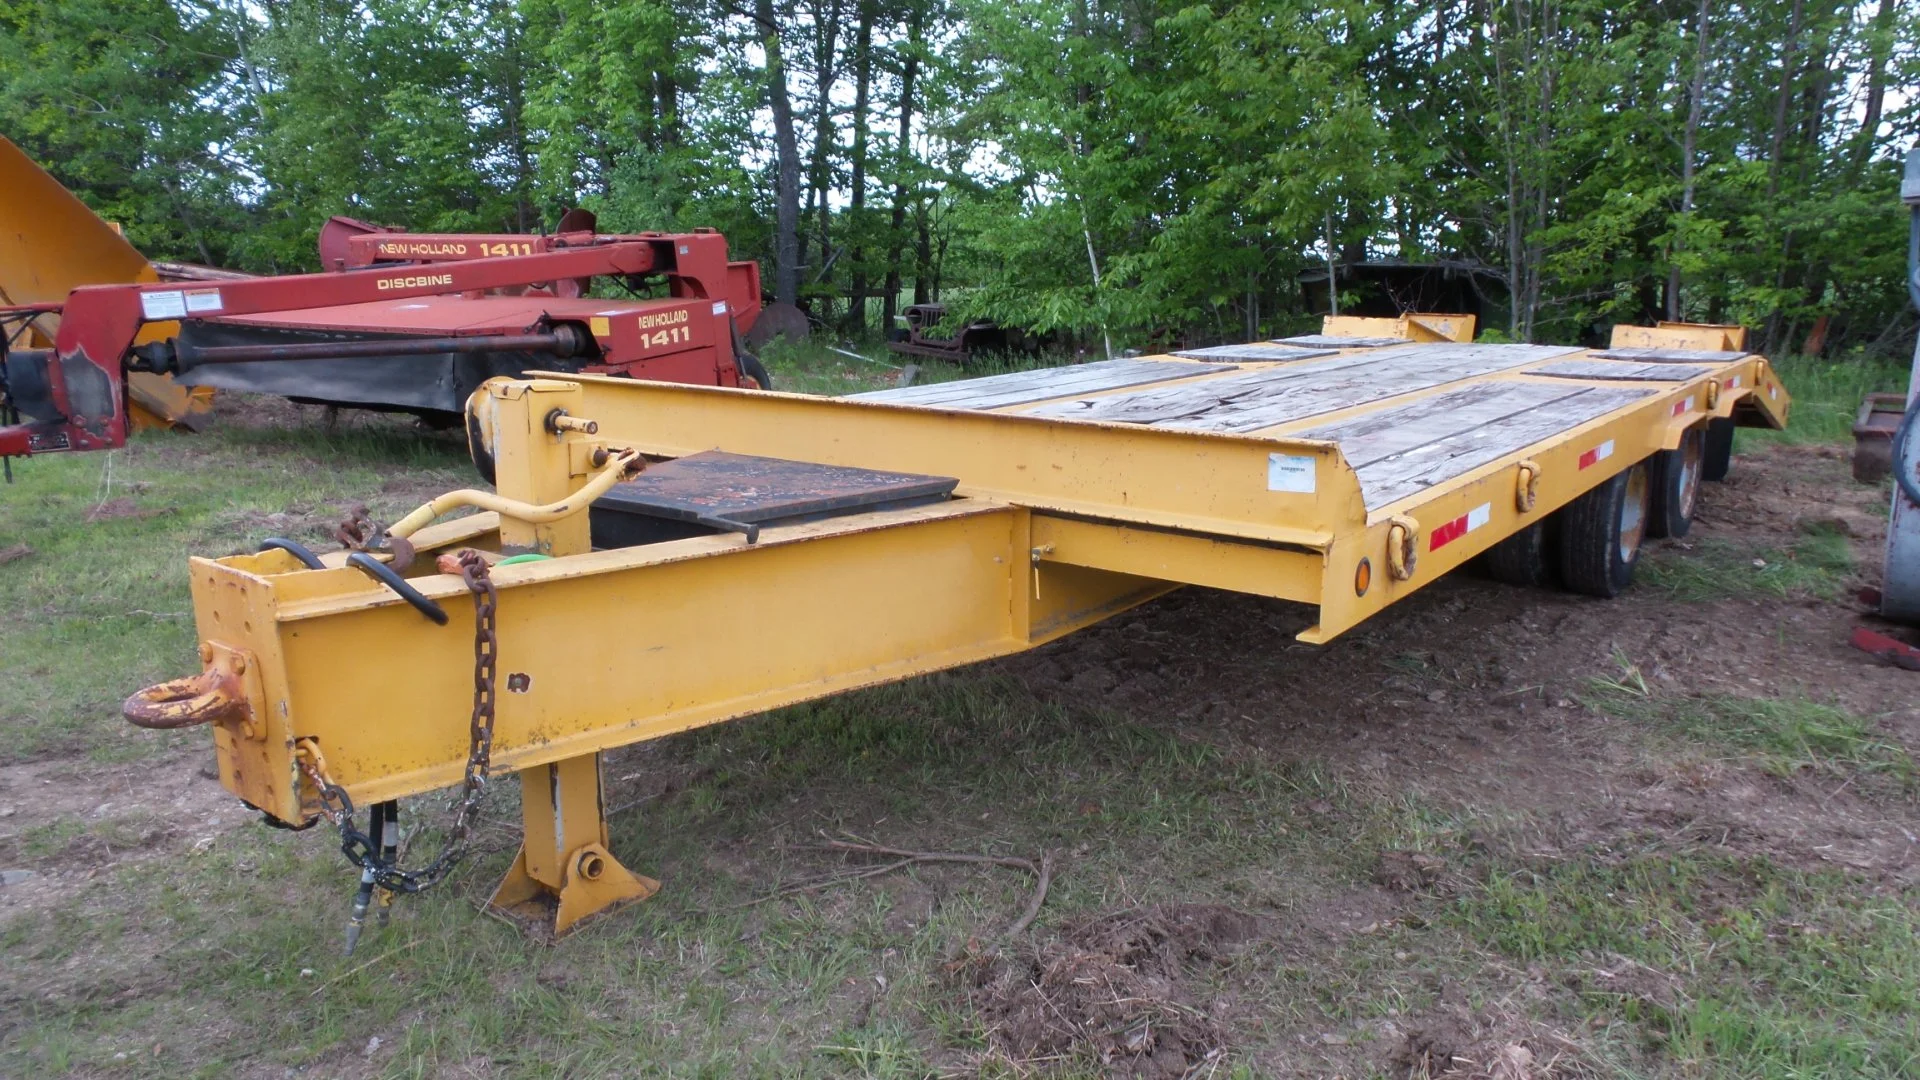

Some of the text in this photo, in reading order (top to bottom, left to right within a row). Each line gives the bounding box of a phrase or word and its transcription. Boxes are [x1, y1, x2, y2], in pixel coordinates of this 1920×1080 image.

[378, 243, 531, 257] NEW HOLLAND 1411
[377, 274, 452, 290] DISCBINE
[638, 310, 688, 329] NEW HOLLAND
[640, 326, 690, 349] 1411
